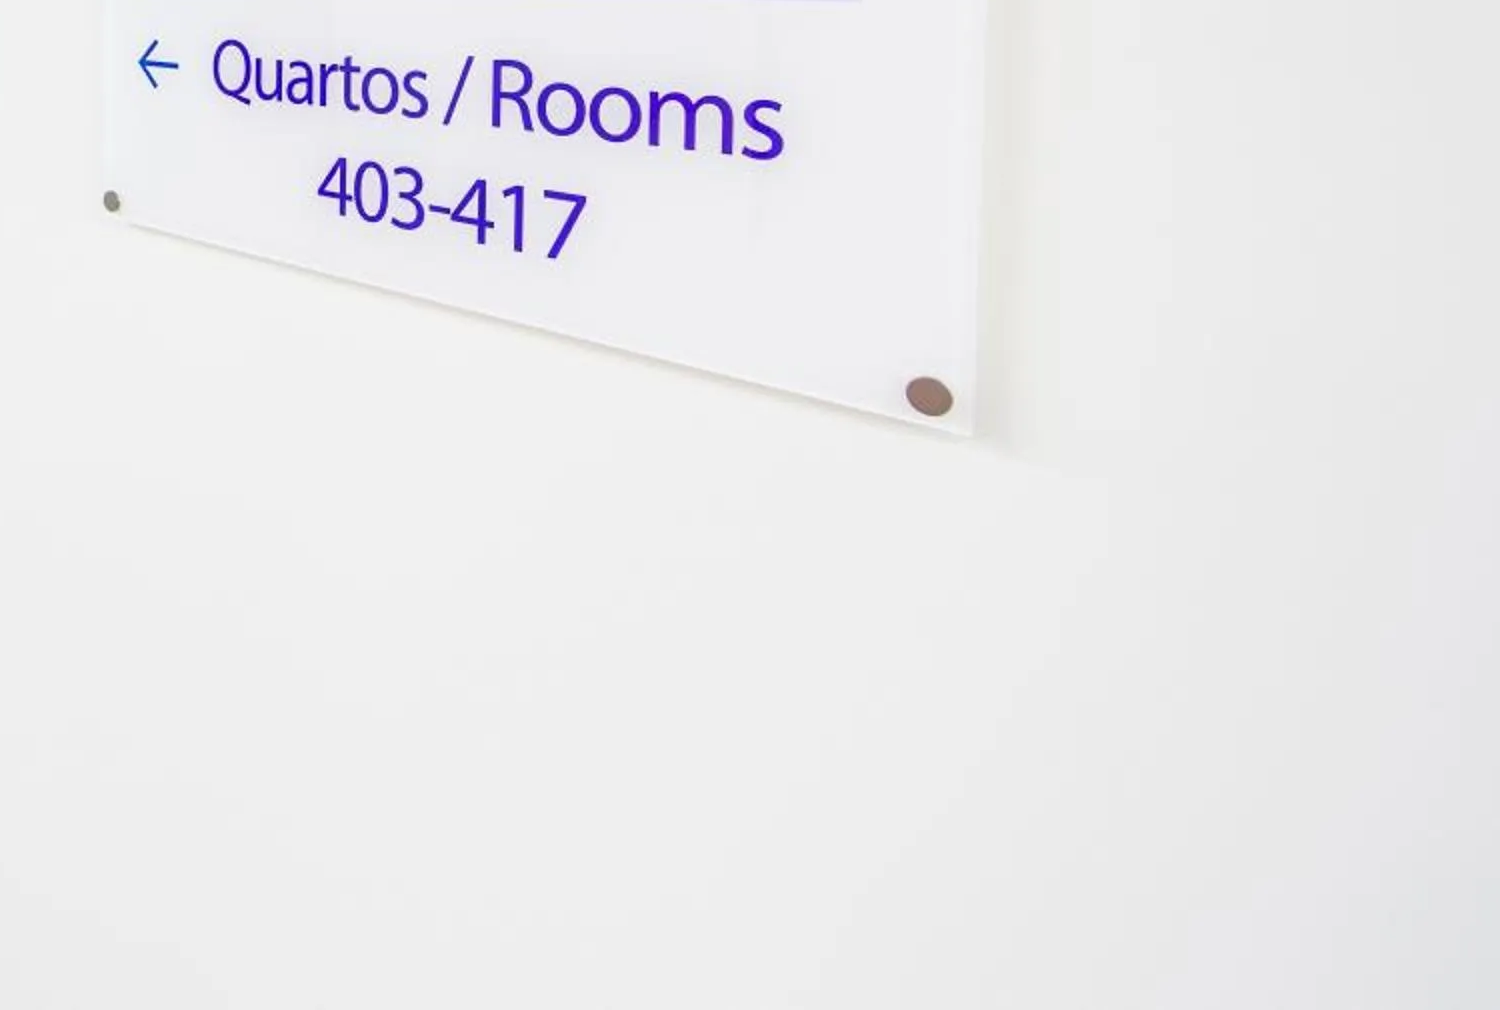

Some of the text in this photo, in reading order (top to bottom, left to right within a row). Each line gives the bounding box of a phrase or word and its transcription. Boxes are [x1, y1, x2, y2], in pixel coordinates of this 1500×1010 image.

[212, 38, 786, 162] Quartos / Rooms
[316, 156, 588, 260] 403-417
